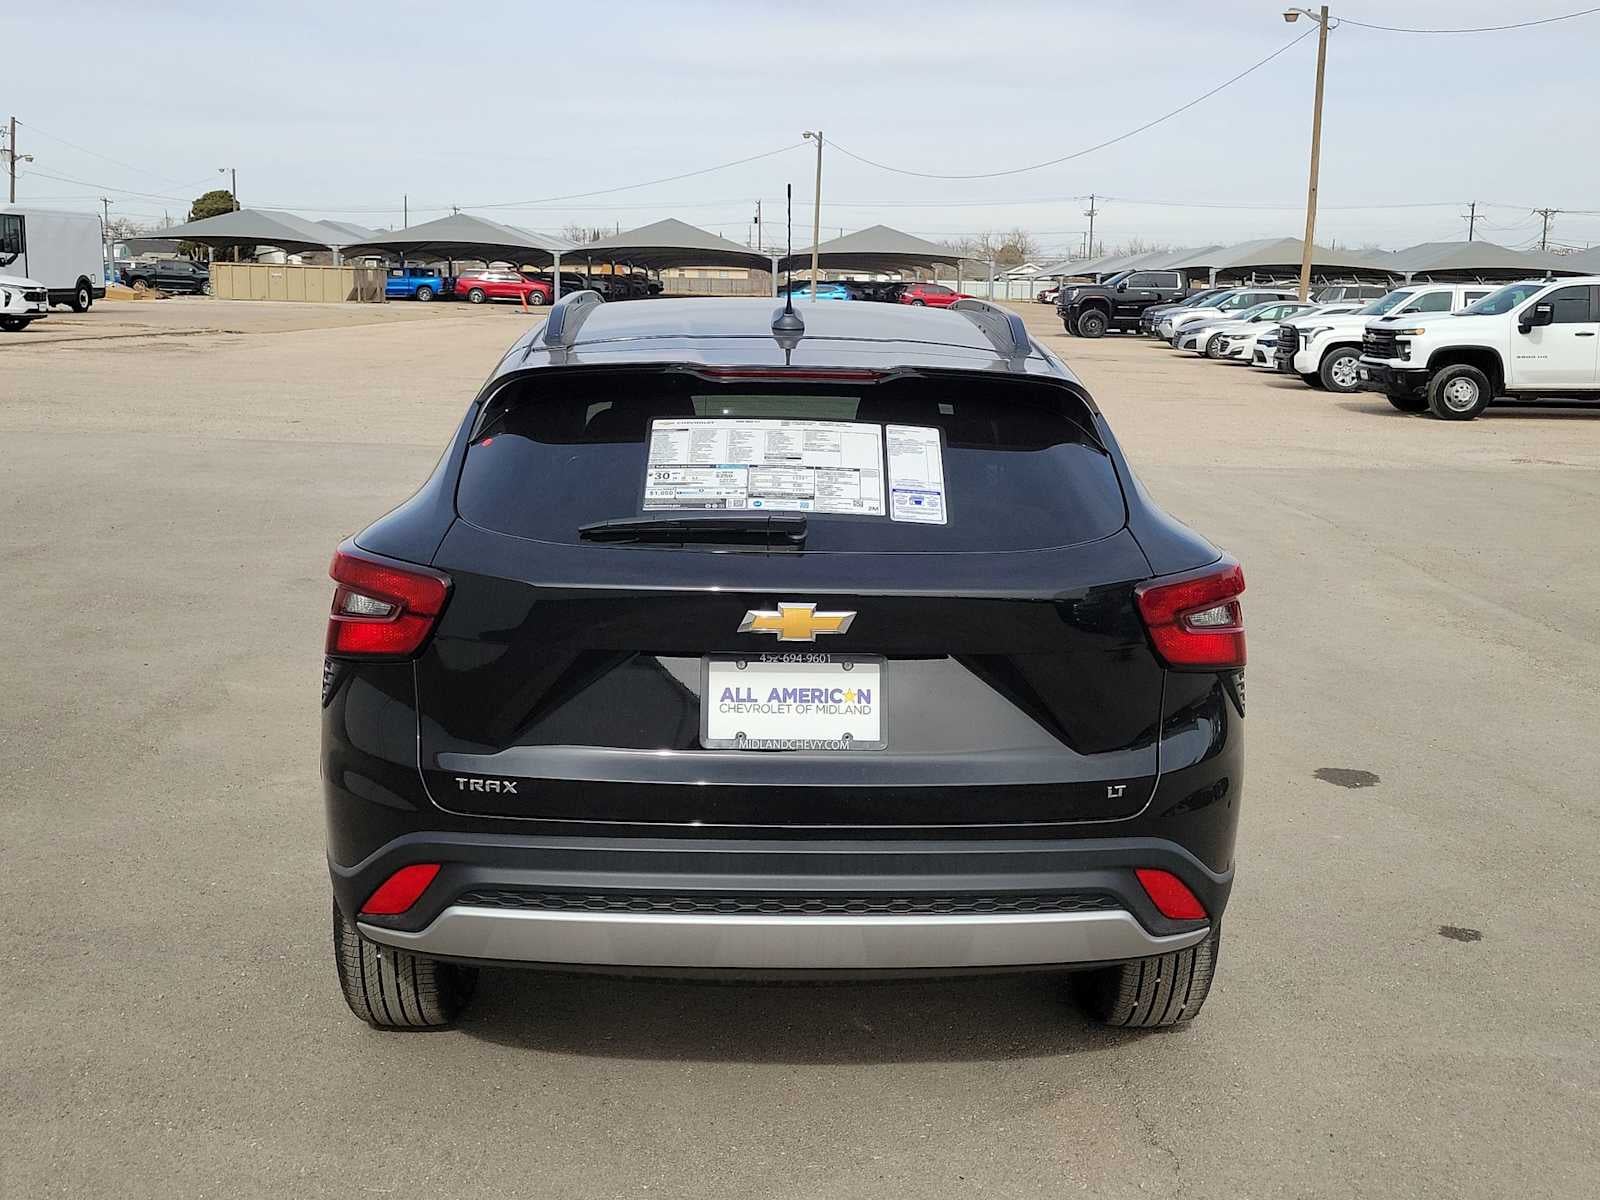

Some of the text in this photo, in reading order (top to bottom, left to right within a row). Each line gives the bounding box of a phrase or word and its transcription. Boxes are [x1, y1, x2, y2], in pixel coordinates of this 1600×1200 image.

[655, 472, 670, 480] 30
[720, 687, 758, 703] ALL
[719, 703, 871, 715] CHEVROLET OF MIDLAND
[739, 739, 850, 750] MIDLANDCHEVY.COM
[455, 778, 518, 794] TRAX
[1107, 785, 1126, 799] LT
